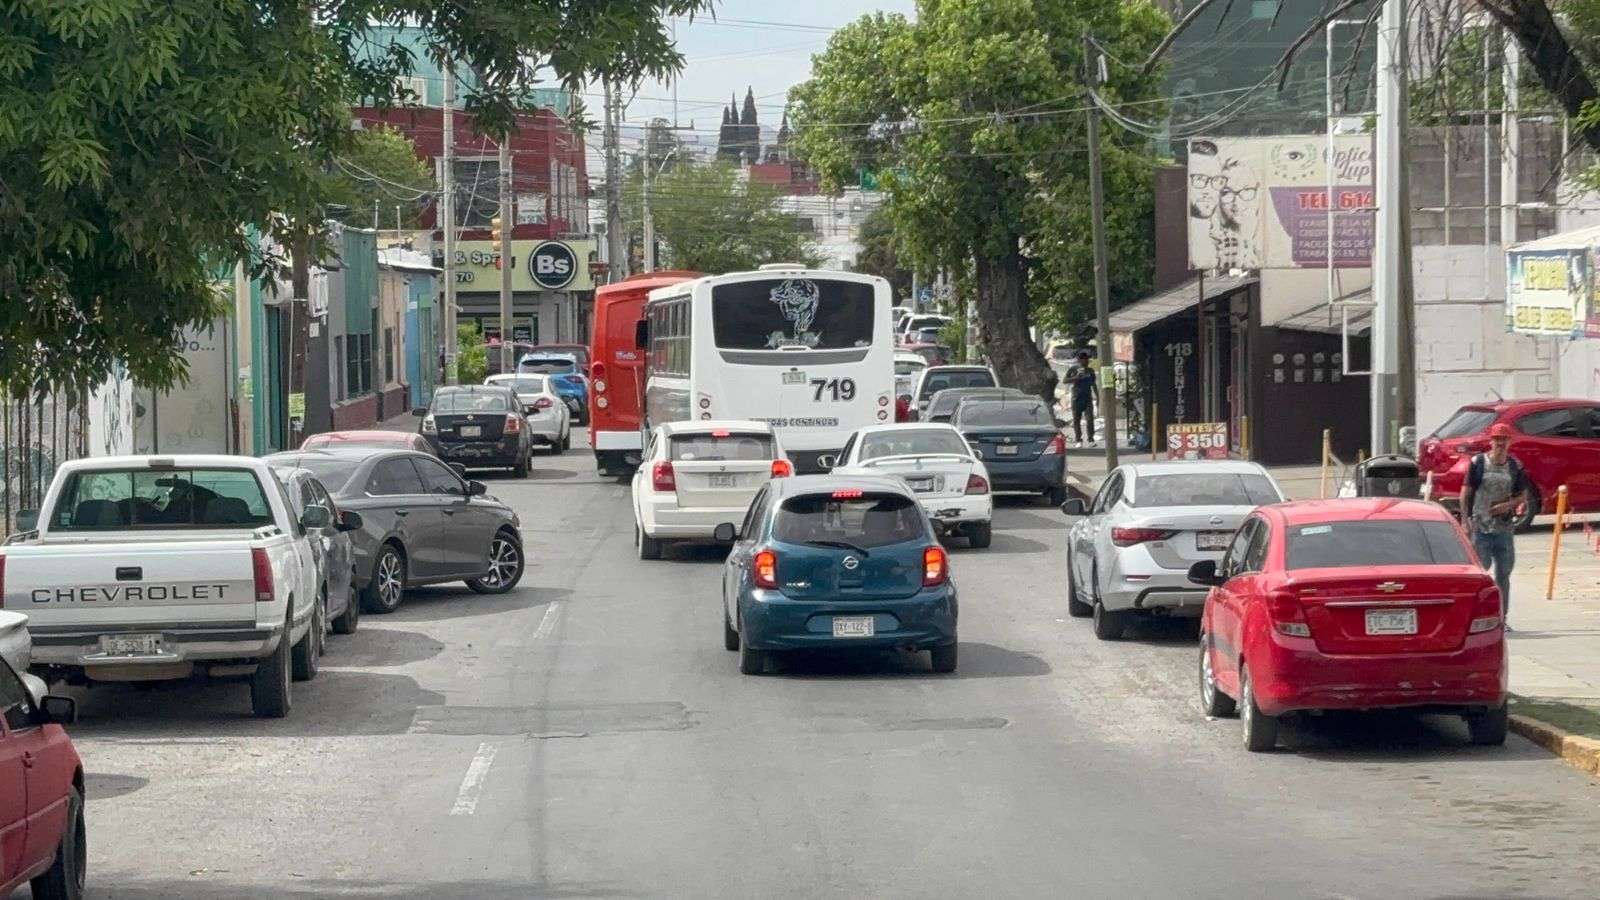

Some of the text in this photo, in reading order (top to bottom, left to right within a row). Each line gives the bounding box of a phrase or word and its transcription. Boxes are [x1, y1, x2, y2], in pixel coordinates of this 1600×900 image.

[455, 251, 466, 264] &
[537, 255, 569, 274] Bs
[1164, 342, 1192, 357] 118
[810, 378, 856, 402] 719
[789, 417, 839, 427] CONTINUAS
[1168, 433, 1226, 450] $ 350
[31, 584, 229, 603] CHEVROLET
